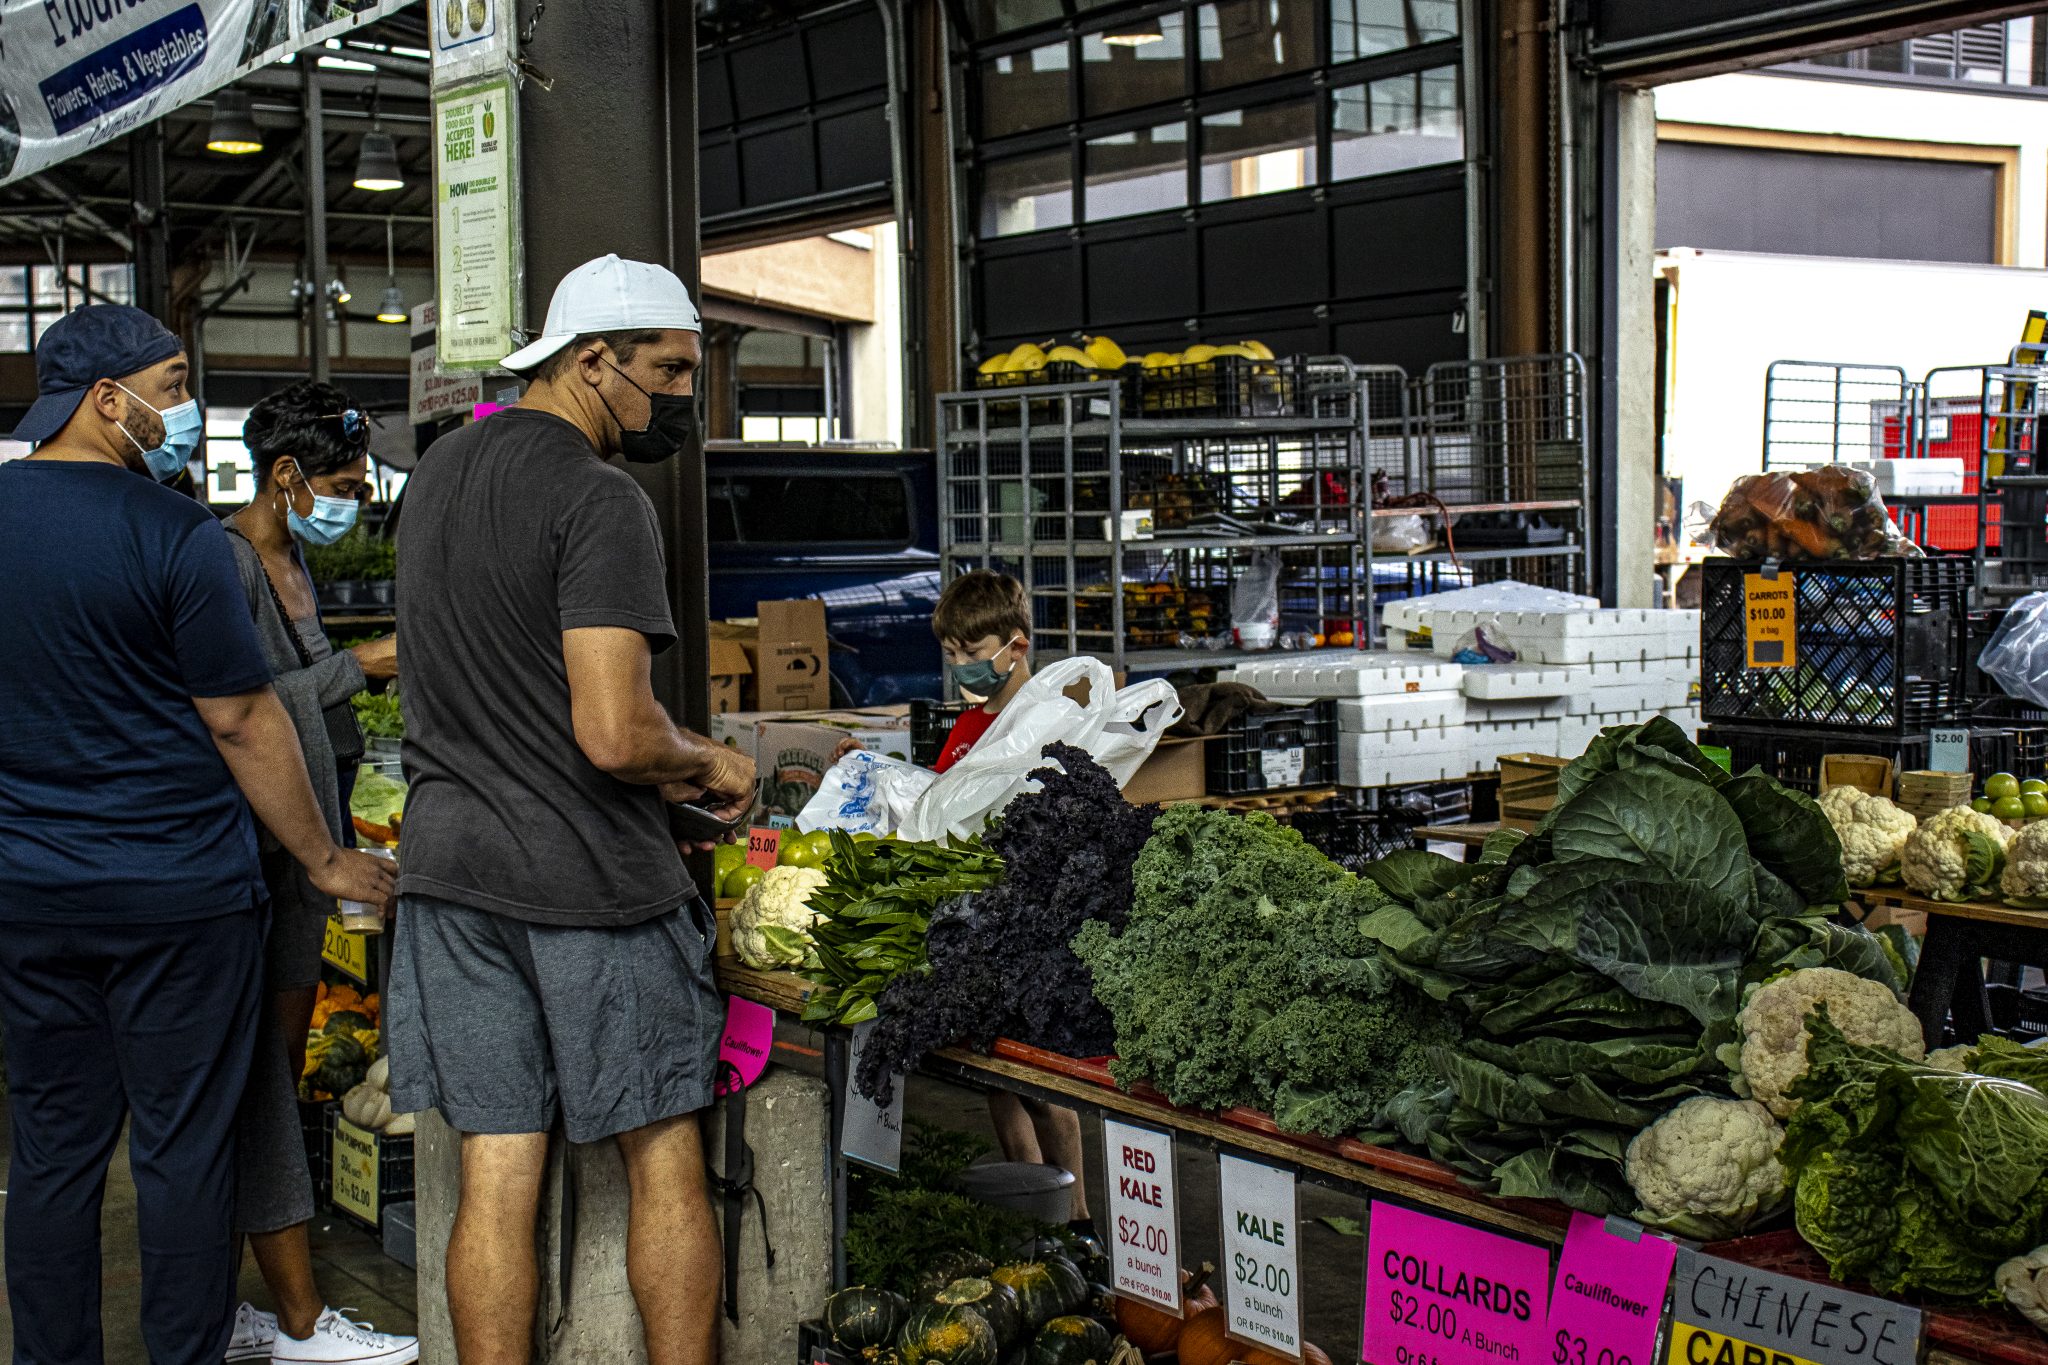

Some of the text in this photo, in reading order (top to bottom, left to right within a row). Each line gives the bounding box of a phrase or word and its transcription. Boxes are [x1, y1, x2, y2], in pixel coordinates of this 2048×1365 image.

[47, 28, 205, 120] Flowers, Herbs, & Vegetables
[446, 106, 465, 119] DOUBLE
[446, 127, 474, 142] ACCEPTED
[446, 138, 474, 162] HERE!
[450, 182, 468, 198] HOW
[452, 245, 462, 273] 2
[452, 284, 462, 312] 3
[451, 385, 479, 404] $25.00
[1749, 590, 1789, 600] CARROTS
[1750, 608, 1785, 621] $10.00
[1766, 626, 1779, 635] bag
[1935, 734, 1964, 743] $2.00
[778, 748, 825, 772] CABBAGE
[749, 838, 776, 853] $3.00
[322, 930, 350, 964] 2.00
[724, 1035, 764, 1058] Cauliflower
[877, 1110, 883, 1125] A
[344, 1132, 372, 1157] PUMPKINS
[1122, 1145, 1155, 1174] RED
[351, 1183, 370, 1207] $2.00
[1120, 1176, 1162, 1208] KALE
[1118, 1215, 1168, 1256] $2.00
[1237, 1210, 1284, 1246] KALE
[1127, 1256, 1162, 1278] a bunch
[1234, 1251, 1290, 1297] $2.00
[1120, 1276, 1171, 1302] OR 6 FOR $10.00
[1383, 1250, 1531, 1321] COLLARDS
[1564, 1273, 1648, 1318] Cauliflower
[1245, 1296, 1283, 1320] a bunch
[1692, 1266, 1896, 1365] CHINESE
[1237, 1316, 1294, 1346] OR 6 FOR $10.00
[1390, 1288, 1519, 1361] $2.00 A Bunch
[1396, 1346, 1414, 1365] Or
[1418, 1354, 1427, 1365] 6
